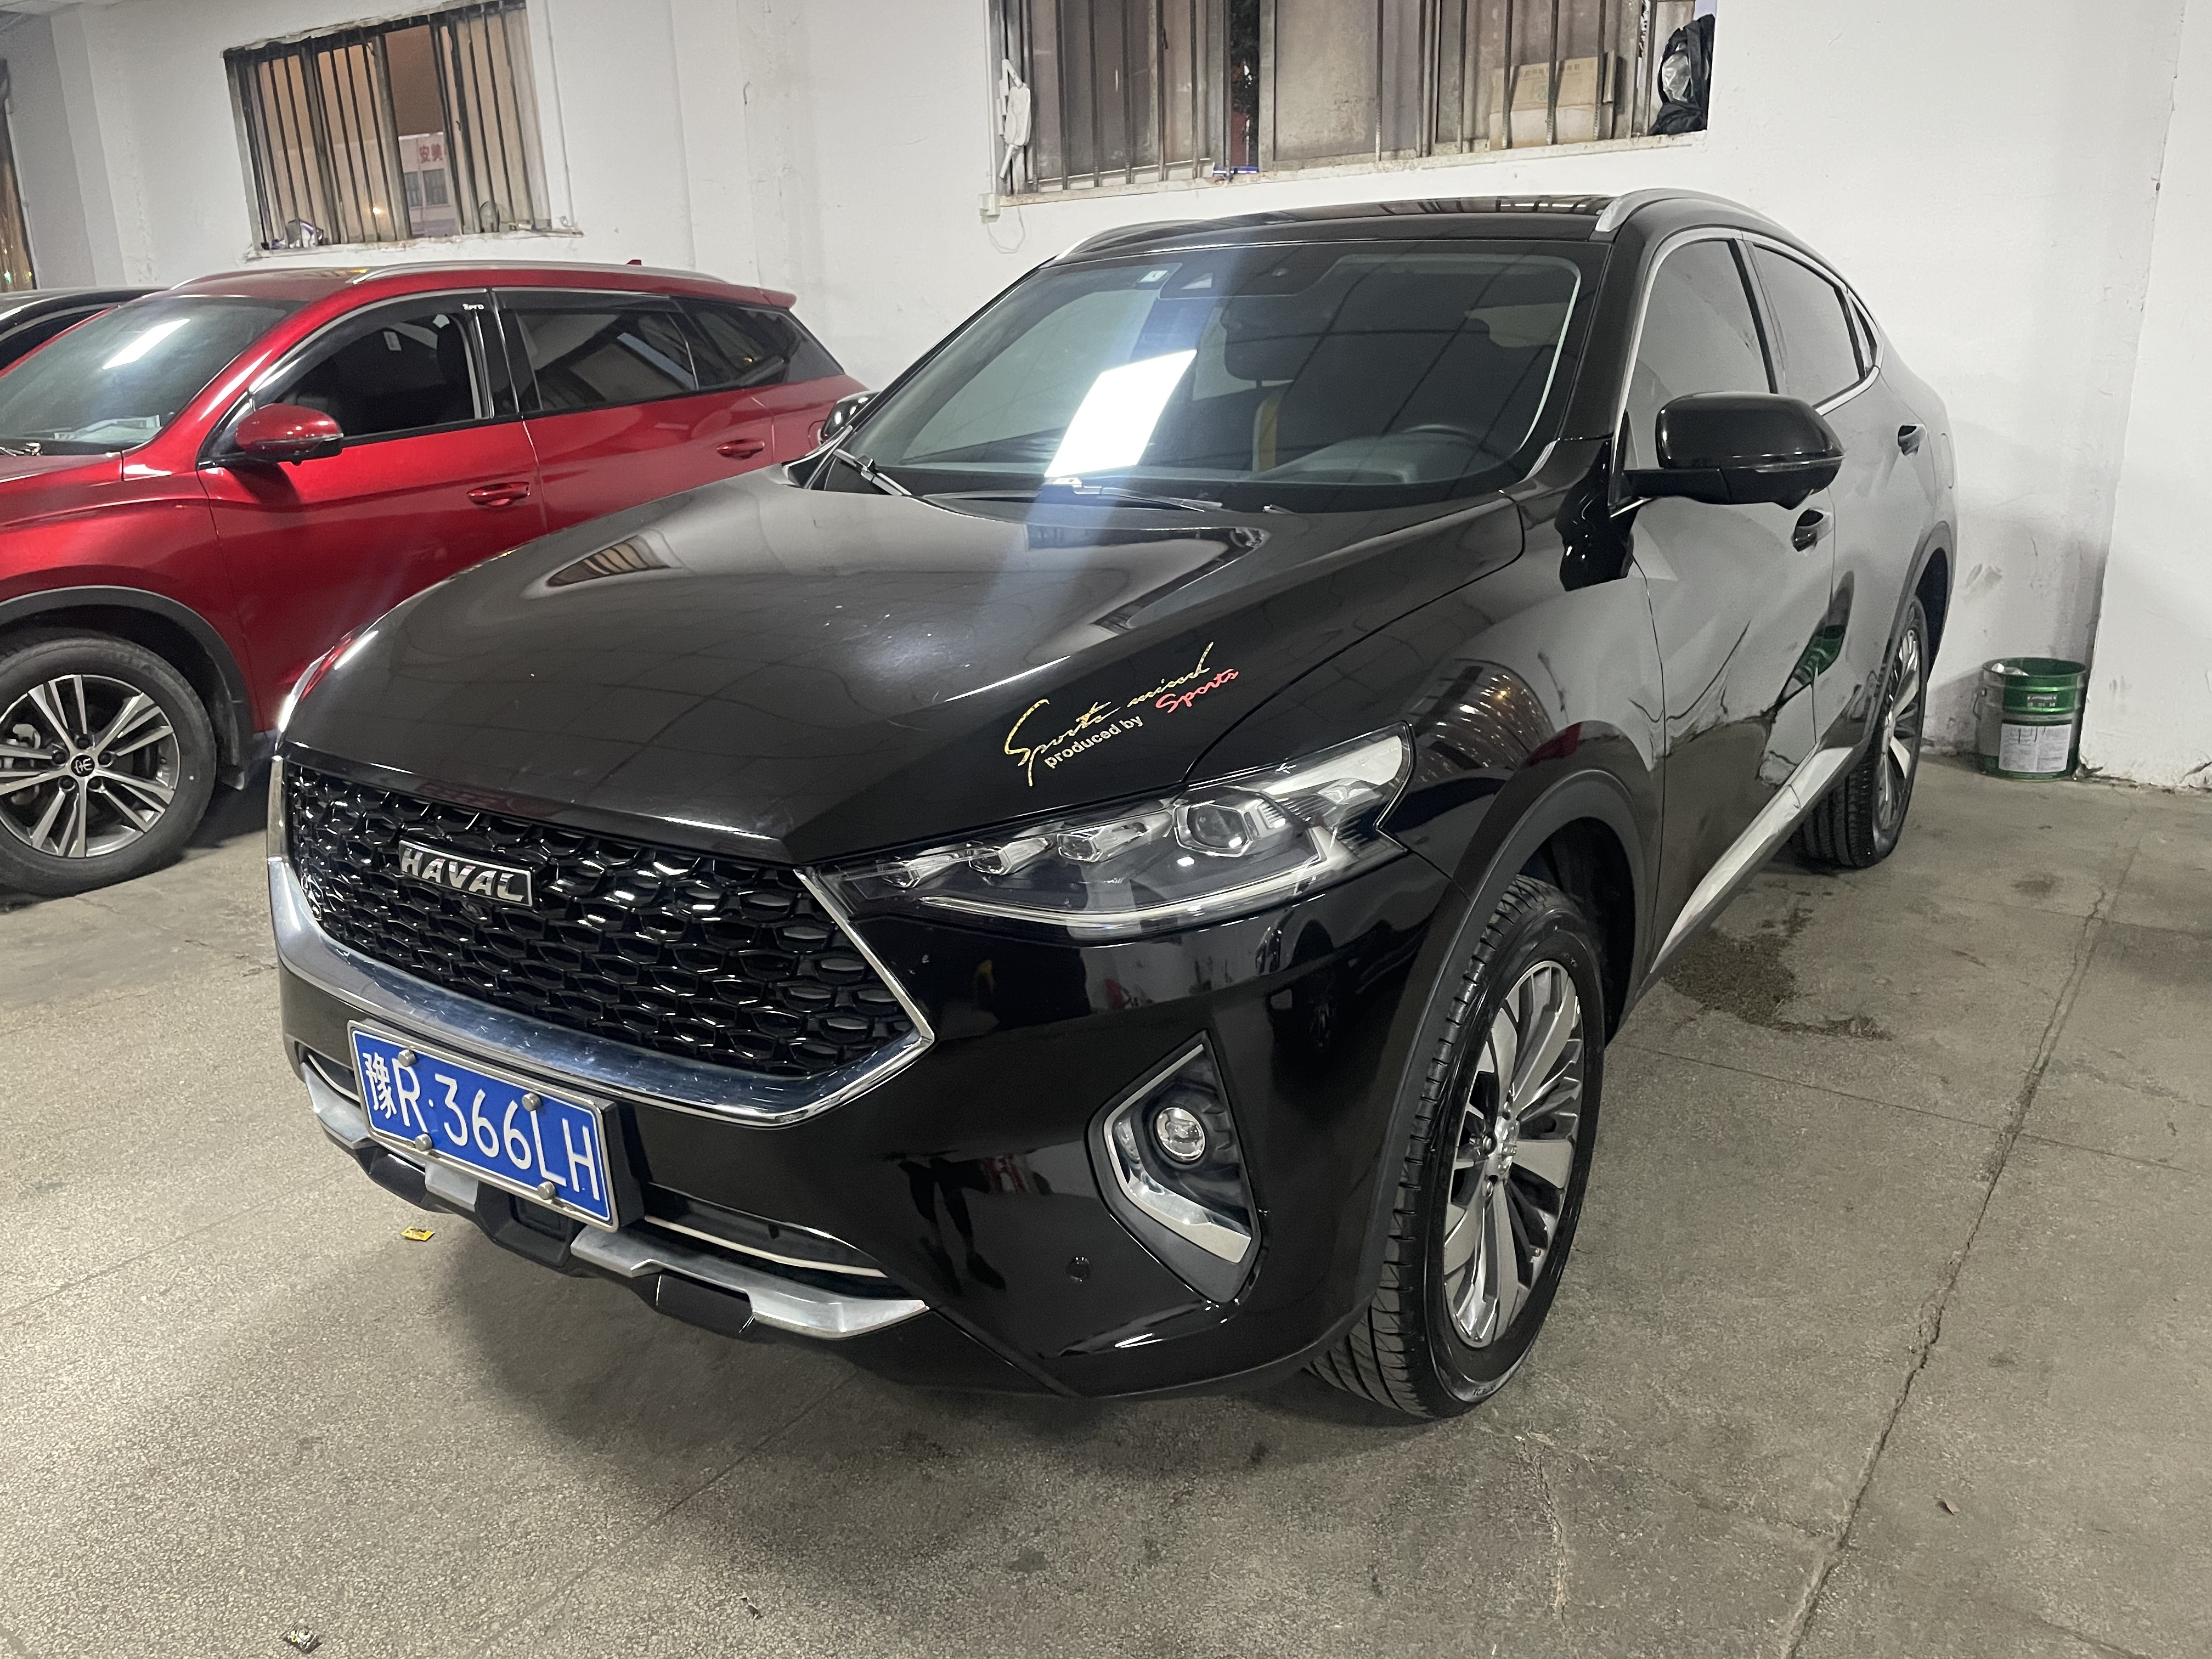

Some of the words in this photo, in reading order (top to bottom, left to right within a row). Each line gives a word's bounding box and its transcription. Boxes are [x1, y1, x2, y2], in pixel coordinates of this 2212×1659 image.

[1044, 724, 1121, 769] produced
[1121, 715, 1143, 730] by
[1155, 668, 1239, 713] Sports
[401, 848, 524, 902] HAVAL
